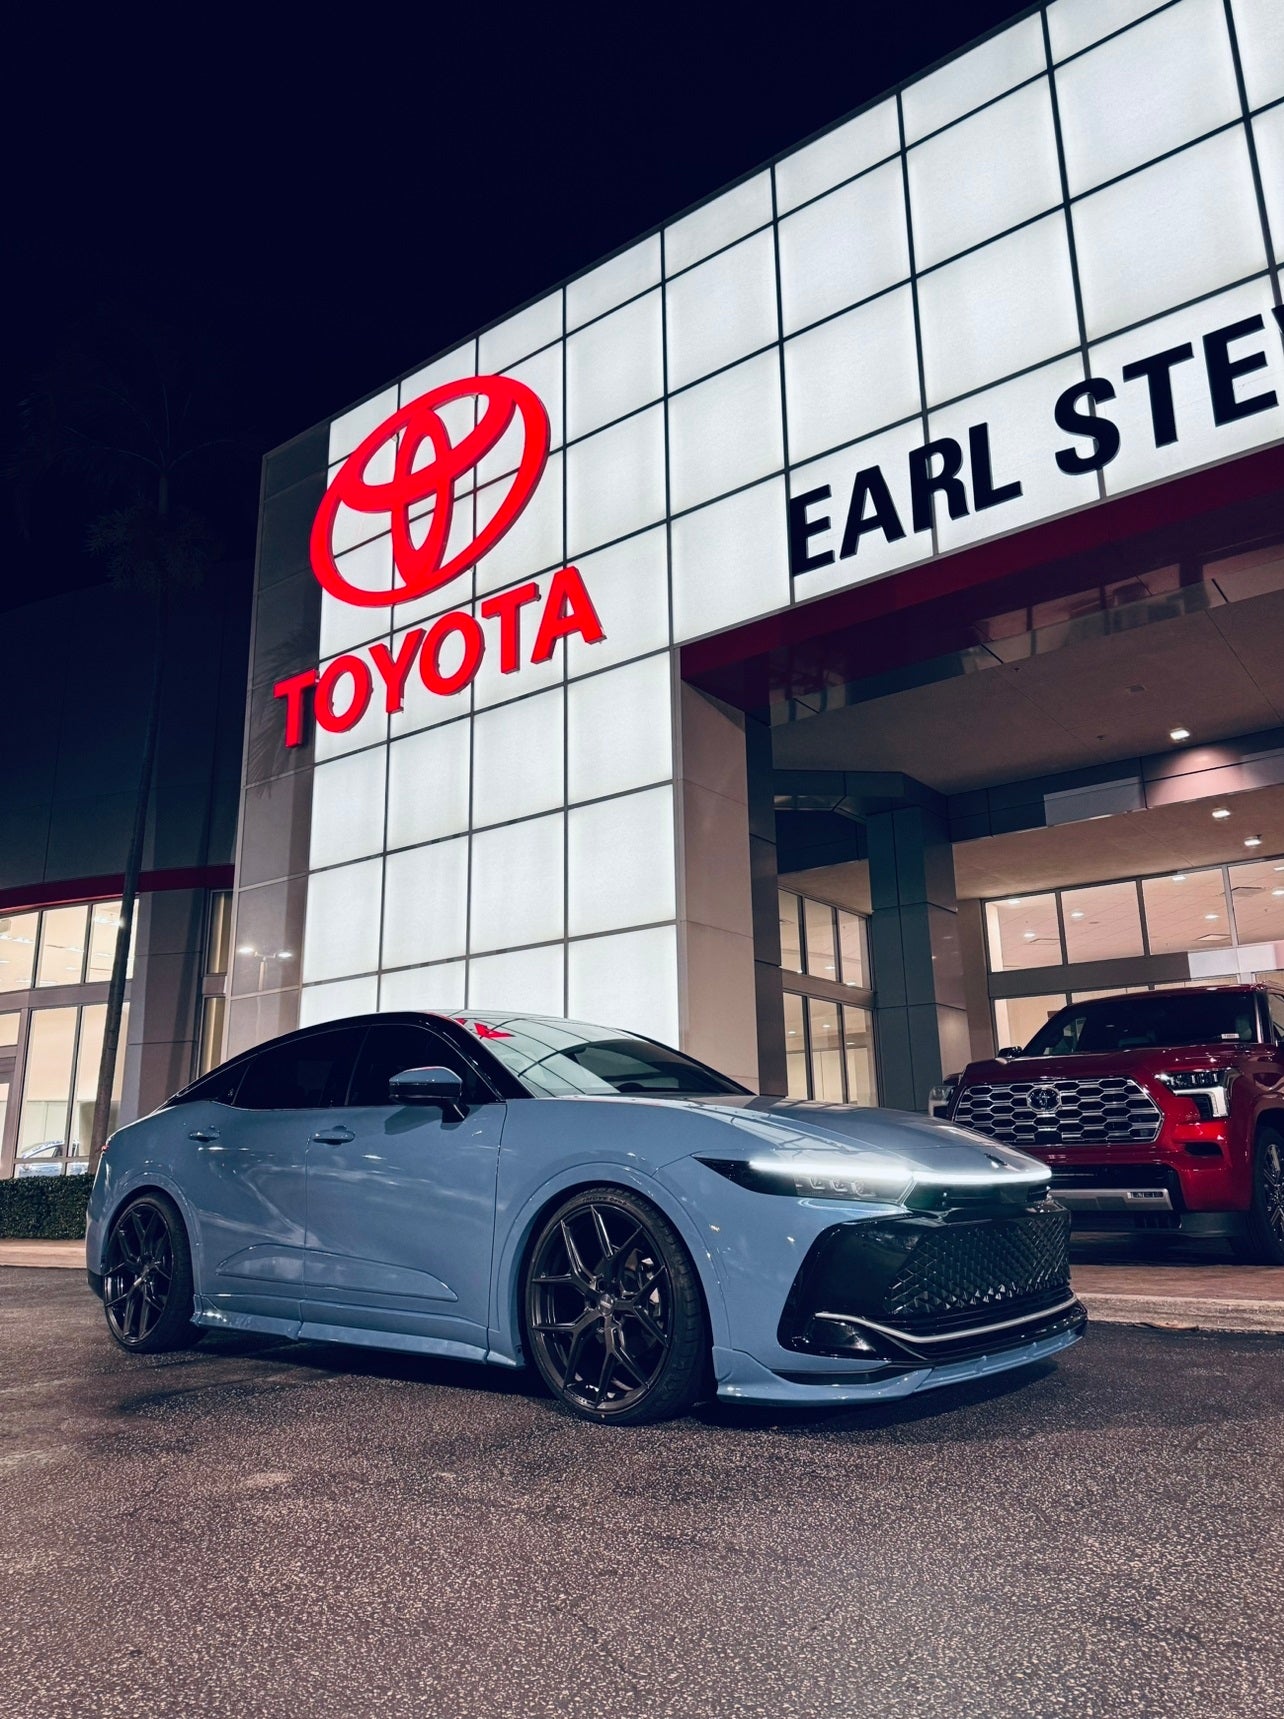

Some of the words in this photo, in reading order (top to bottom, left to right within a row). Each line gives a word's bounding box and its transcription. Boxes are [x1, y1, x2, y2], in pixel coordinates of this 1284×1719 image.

[789, 422, 1023, 577] EARL
[1054, 304, 1284, 476] STE
[273, 566, 607, 748] TOYOTA
